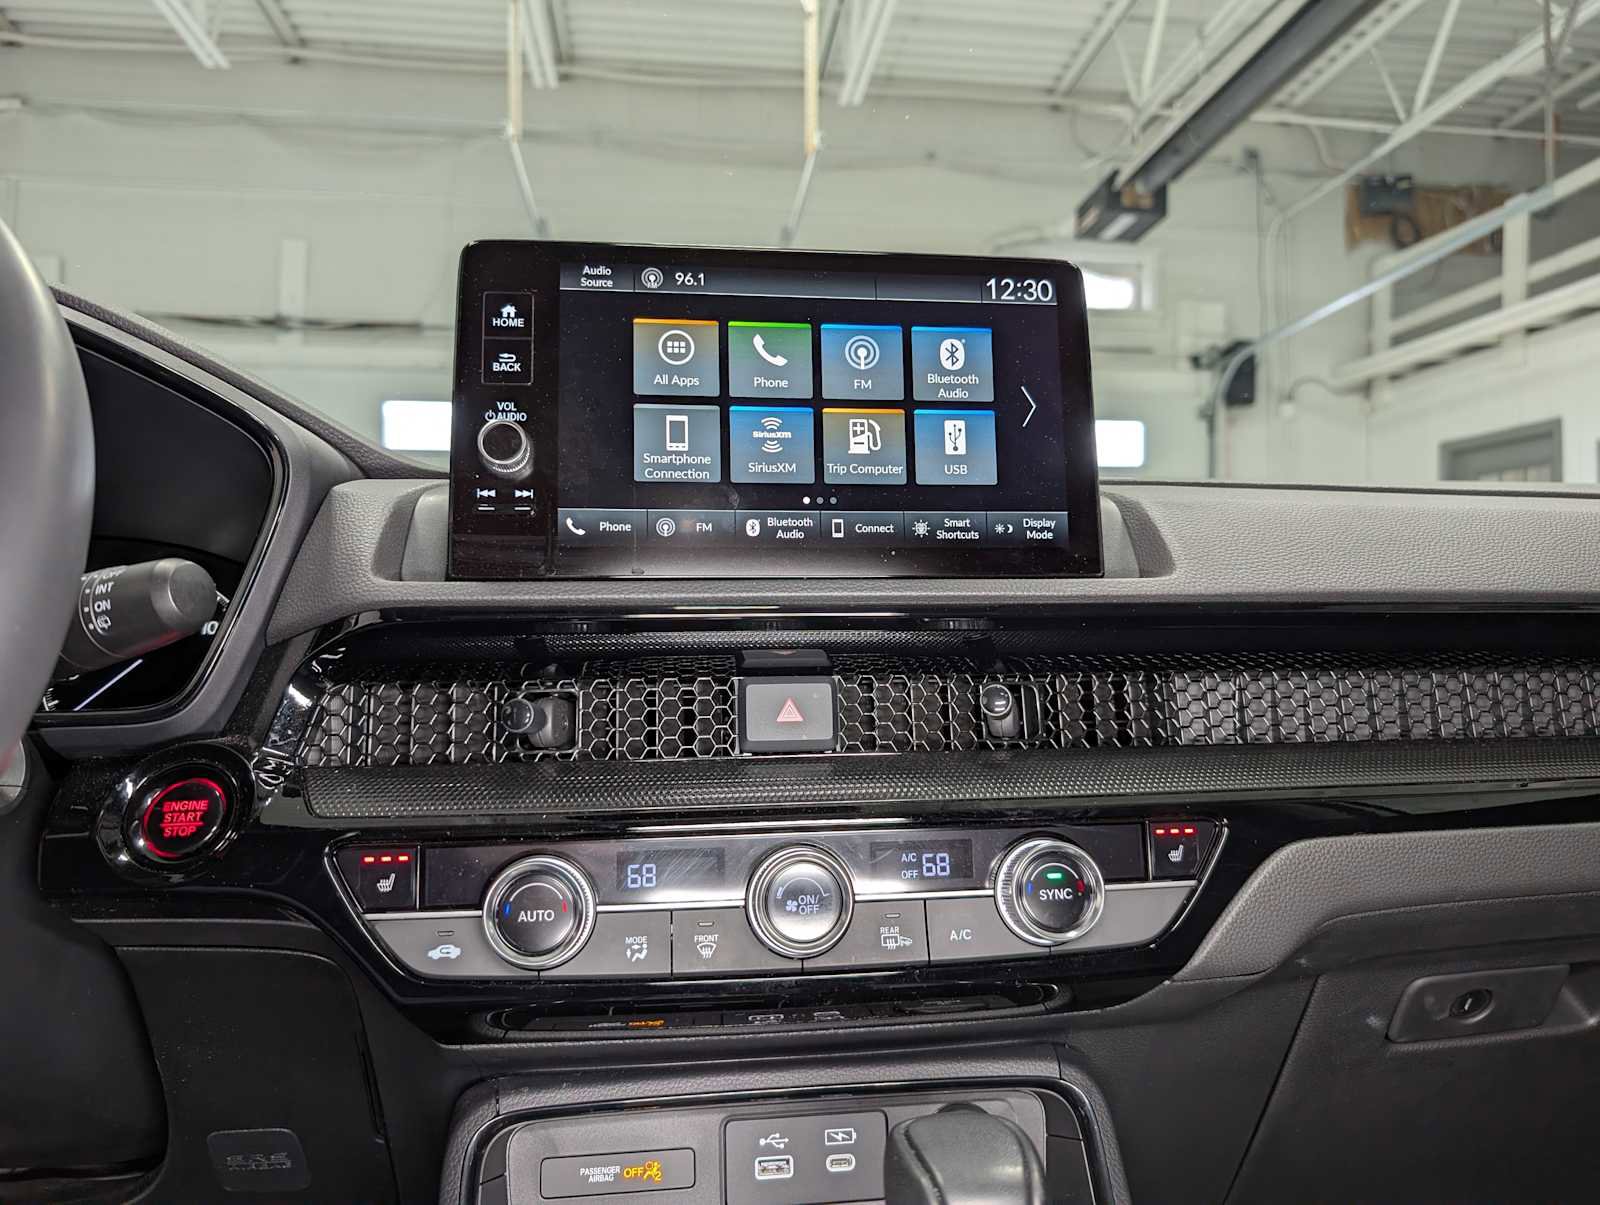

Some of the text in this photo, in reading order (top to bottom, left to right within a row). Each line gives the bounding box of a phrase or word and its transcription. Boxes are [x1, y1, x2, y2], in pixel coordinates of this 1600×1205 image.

[582, 265, 612, 276] Audio
[580, 277, 613, 288] Source
[674, 272, 706, 287] 96.1
[986, 278, 1054, 302] 12:30
[492, 317, 525, 328] HOME
[492, 362, 522, 373] BACK
[653, 374, 700, 388] All Apps
[753, 376, 790, 390] Phone
[853, 379, 873, 391] FM
[927, 373, 980, 386] Bluetooth
[938, 388, 970, 400] Audio
[496, 401, 518, 412] VOL
[497, 411, 528, 423] AUDIO
[642, 453, 712, 468] Smartphone
[748, 461, 797, 473] SiriusXM
[827, 463, 904, 477] Trip Computer
[944, 464, 968, 476] USB
[644, 467, 711, 480] Connection
[599, 521, 632, 534] Phone
[695, 522, 713, 534] FM
[767, 516, 814, 528] Bluetooth
[943, 517, 971, 529] Smart
[1022, 517, 1057, 531] Display
[776, 528, 805, 540] Audio
[855, 523, 895, 535] Connect
[936, 530, 980, 541] Shortcuts
[1026, 531, 1054, 541] Mode
[95, 581, 114, 594] INT
[94, 600, 111, 612] ON
[162, 800, 209, 812] ENGINE
[163, 812, 204, 823] START
[163, 826, 198, 838] STOP
[901, 853, 917, 862] A/C
[922, 852, 950, 877] 68
[627, 863, 657, 888] 68
[901, 870, 919, 880] OFF
[798, 894, 819, 905] ON/
[1039, 888, 1073, 902] SYNC
[799, 904, 820, 915] OFF
[518, 910, 555, 923] AUTO
[880, 926, 900, 934] REAR
[950, 929, 972, 941] A/C
[625, 935, 648, 944] MODE
[694, 934, 719, 943] FRONT
[580, 1165, 621, 1176] PASSENGER
[623, 1167, 644, 1178] OFF
[588, 1174, 614, 1183] AIRBAG
